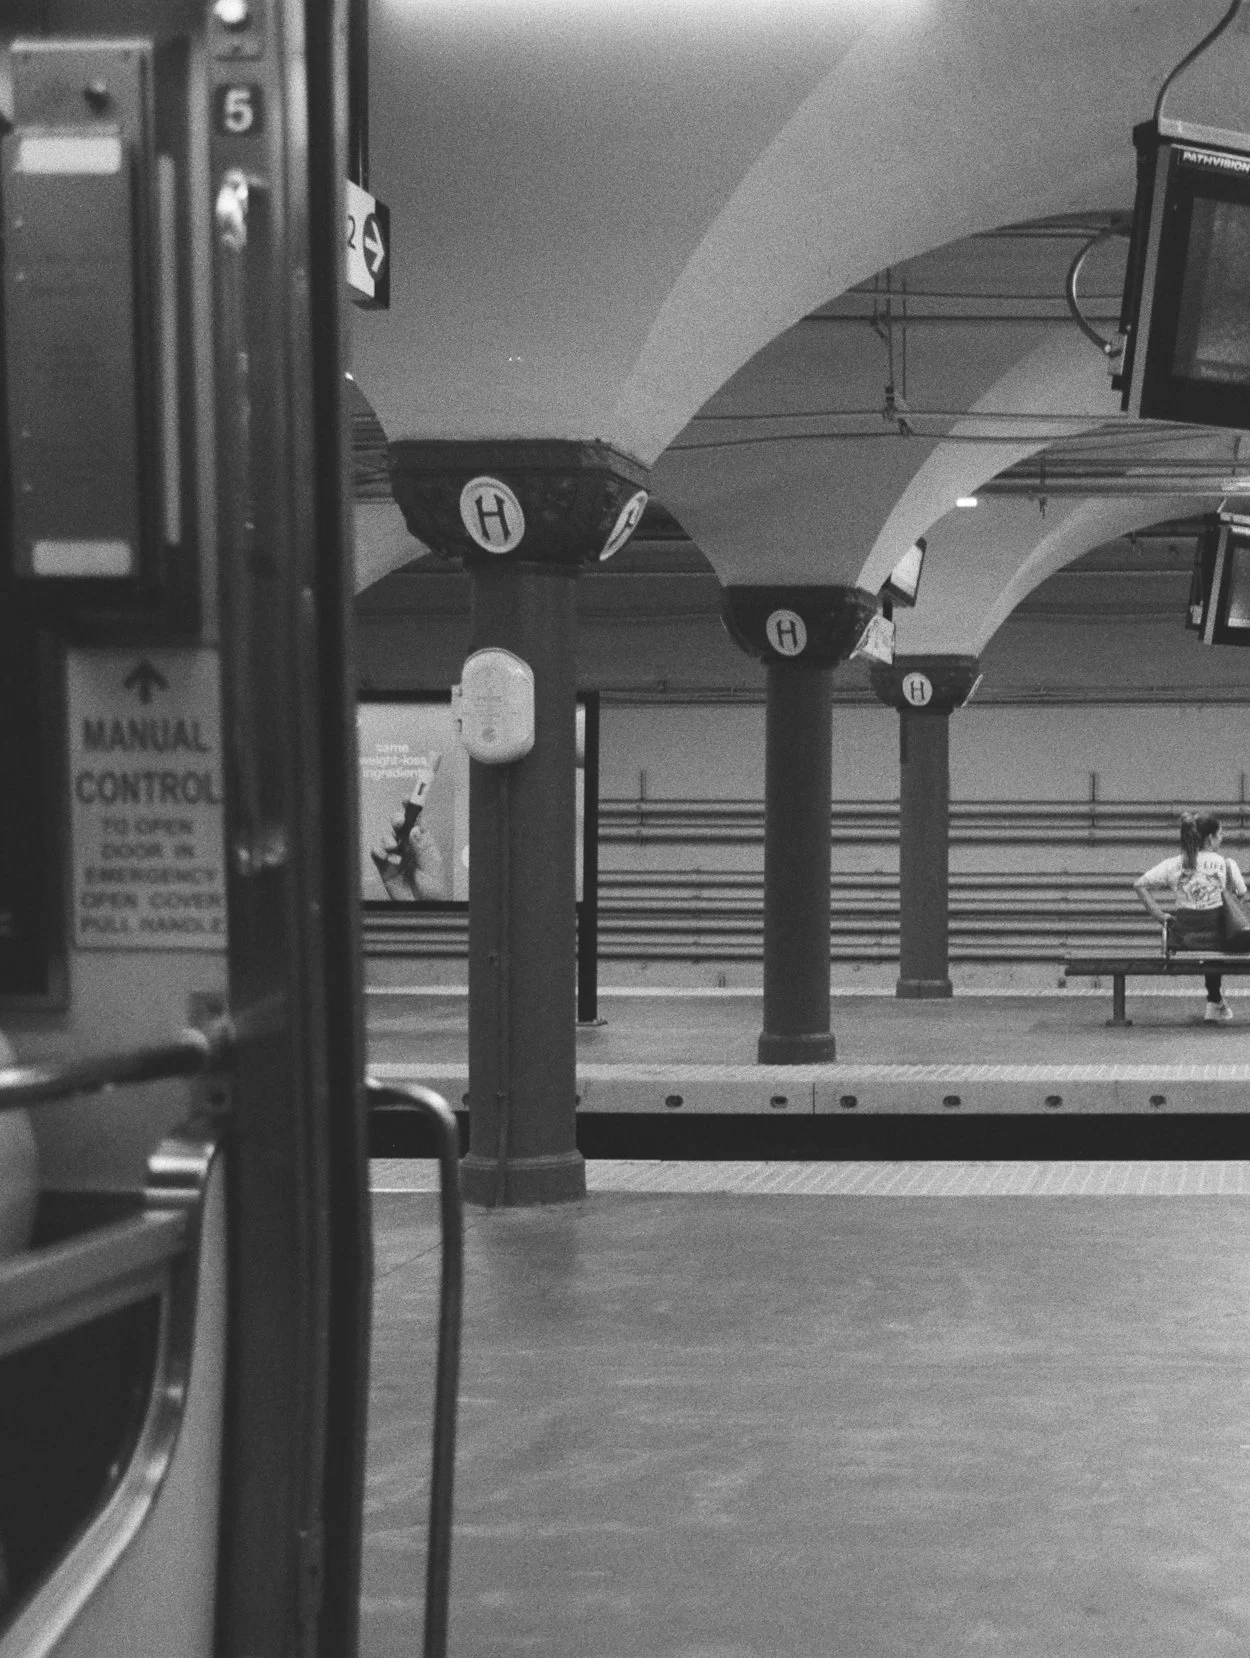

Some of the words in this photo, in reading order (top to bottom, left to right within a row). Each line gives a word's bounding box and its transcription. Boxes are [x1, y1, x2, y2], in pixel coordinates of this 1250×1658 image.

[225, 90, 253, 132] 5
[475, 494, 512, 543] H
[776, 619, 798, 649] H
[83, 719, 212, 754] MANUAL
[76, 771, 219, 805] CONTROL
[135, 817, 193, 835] OPEN
[84, 868, 218, 885] EMERGENCY
[81, 892, 138, 909] OPEN
[81, 917, 128, 934] PULL
[140, 917, 221, 933] HANDLE
